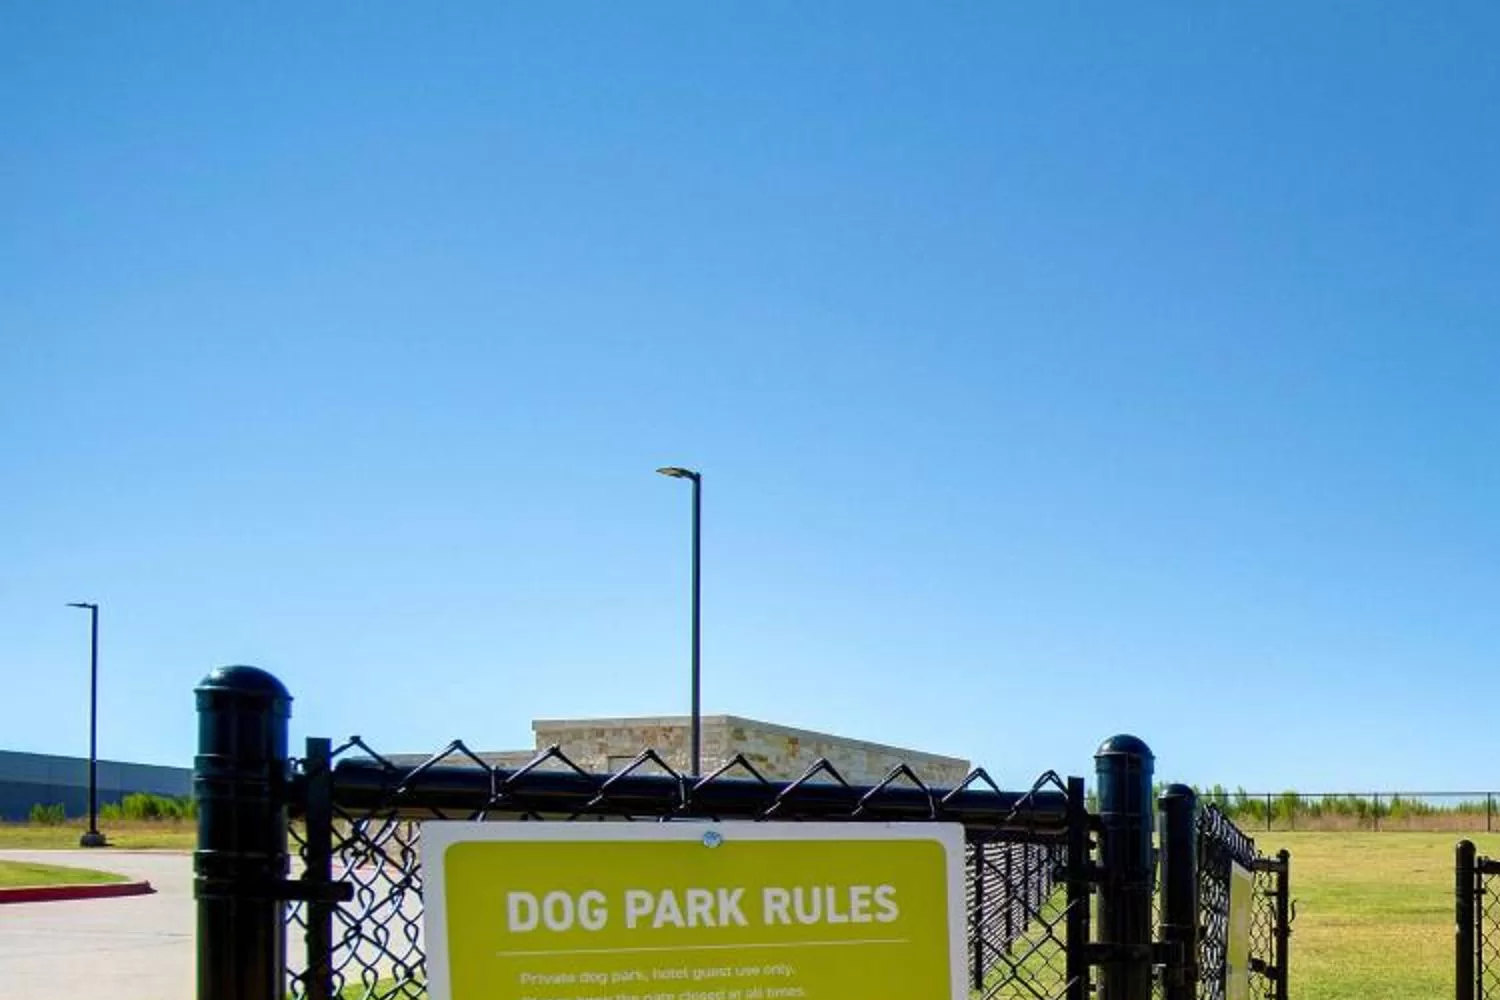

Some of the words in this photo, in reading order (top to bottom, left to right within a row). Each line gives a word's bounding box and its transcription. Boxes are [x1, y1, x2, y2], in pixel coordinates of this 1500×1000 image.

[507, 889, 608, 933] DOG
[625, 887, 749, 929] PARK
[763, 884, 899, 925] RULES
